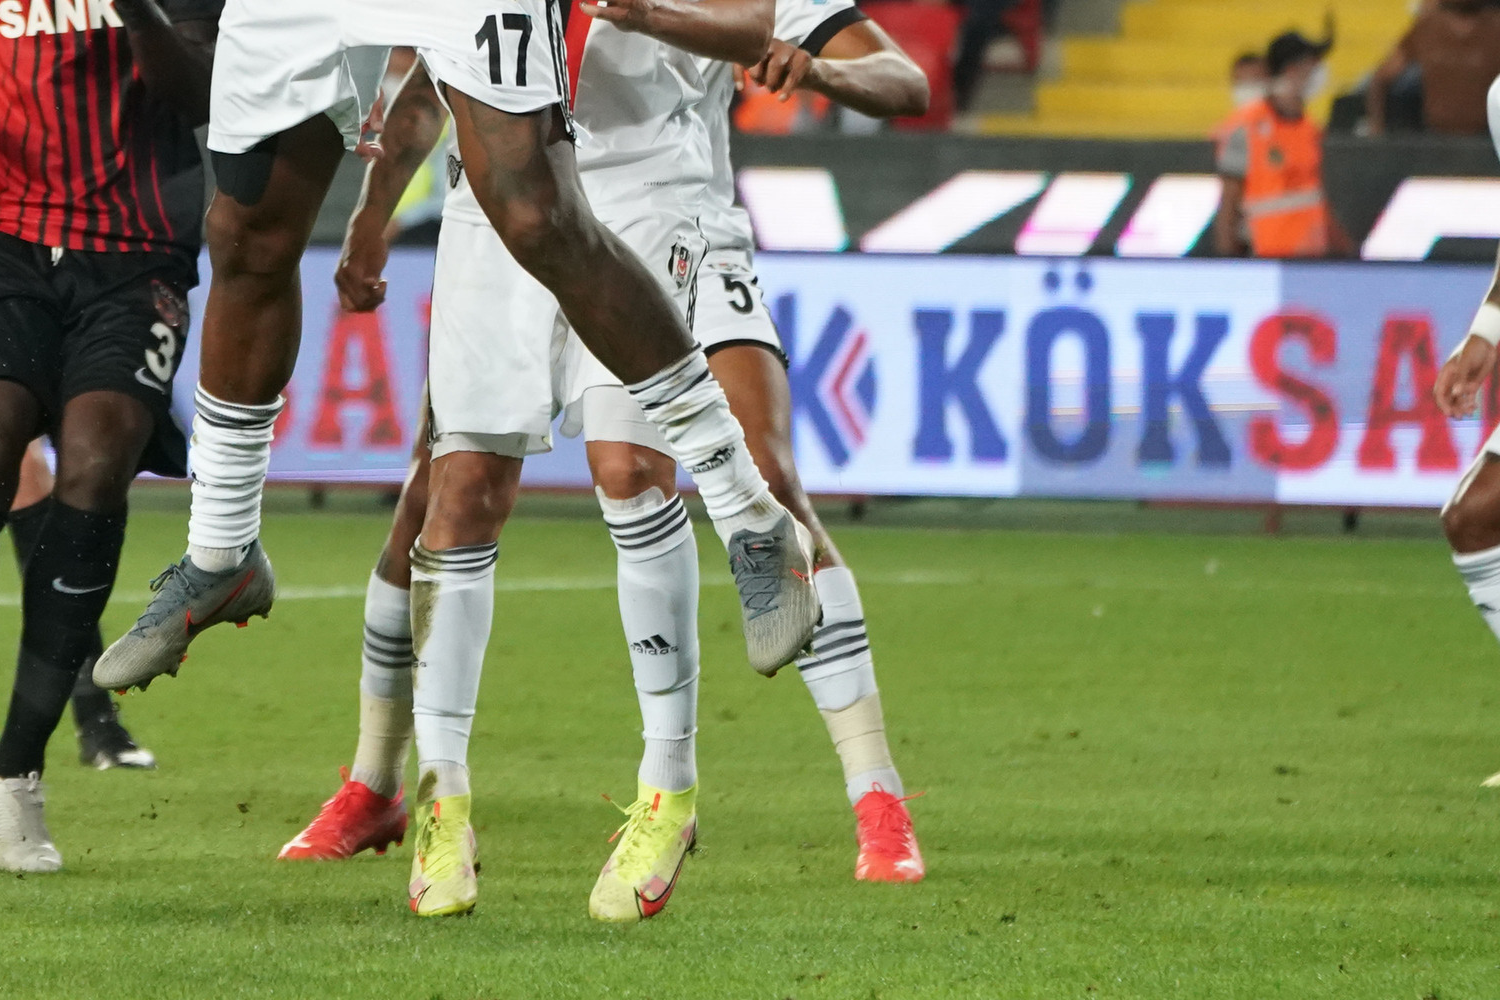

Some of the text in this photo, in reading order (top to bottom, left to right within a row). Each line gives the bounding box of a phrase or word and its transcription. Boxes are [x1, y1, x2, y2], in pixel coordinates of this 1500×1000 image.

[474, 12, 534, 87] 17
[720, 273, 754, 315] 5
[144, 322, 177, 383] 3
[912, 268, 1500, 473] KÖKSA
[630, 643, 680, 656] adidas
